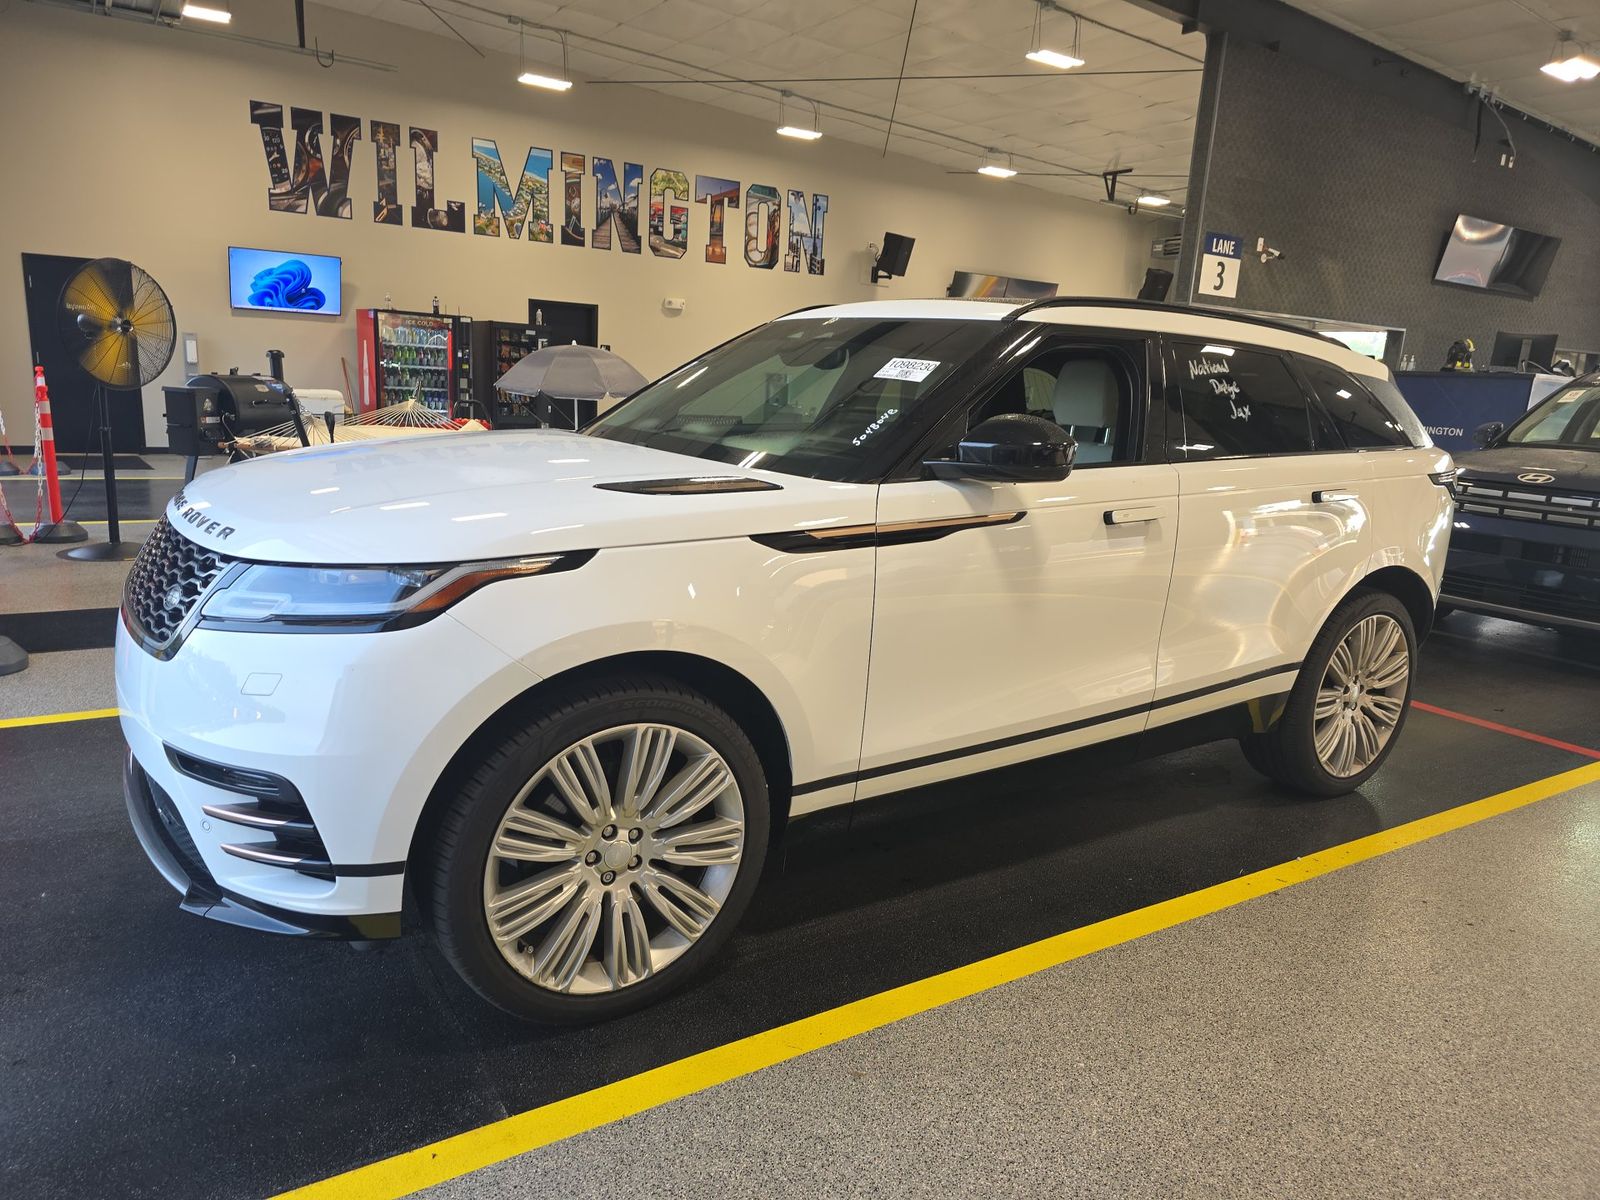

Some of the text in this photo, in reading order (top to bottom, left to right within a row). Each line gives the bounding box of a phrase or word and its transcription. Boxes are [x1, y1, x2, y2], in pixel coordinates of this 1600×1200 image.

[249, 99, 829, 276] WILMINGTON
[1212, 238, 1236, 256] LANE
[1213, 261, 1226, 291] 3
[889, 360, 938, 371] 1098230
[1229, 399, 1252, 422] Jax
[181, 507, 236, 541] ROVER
